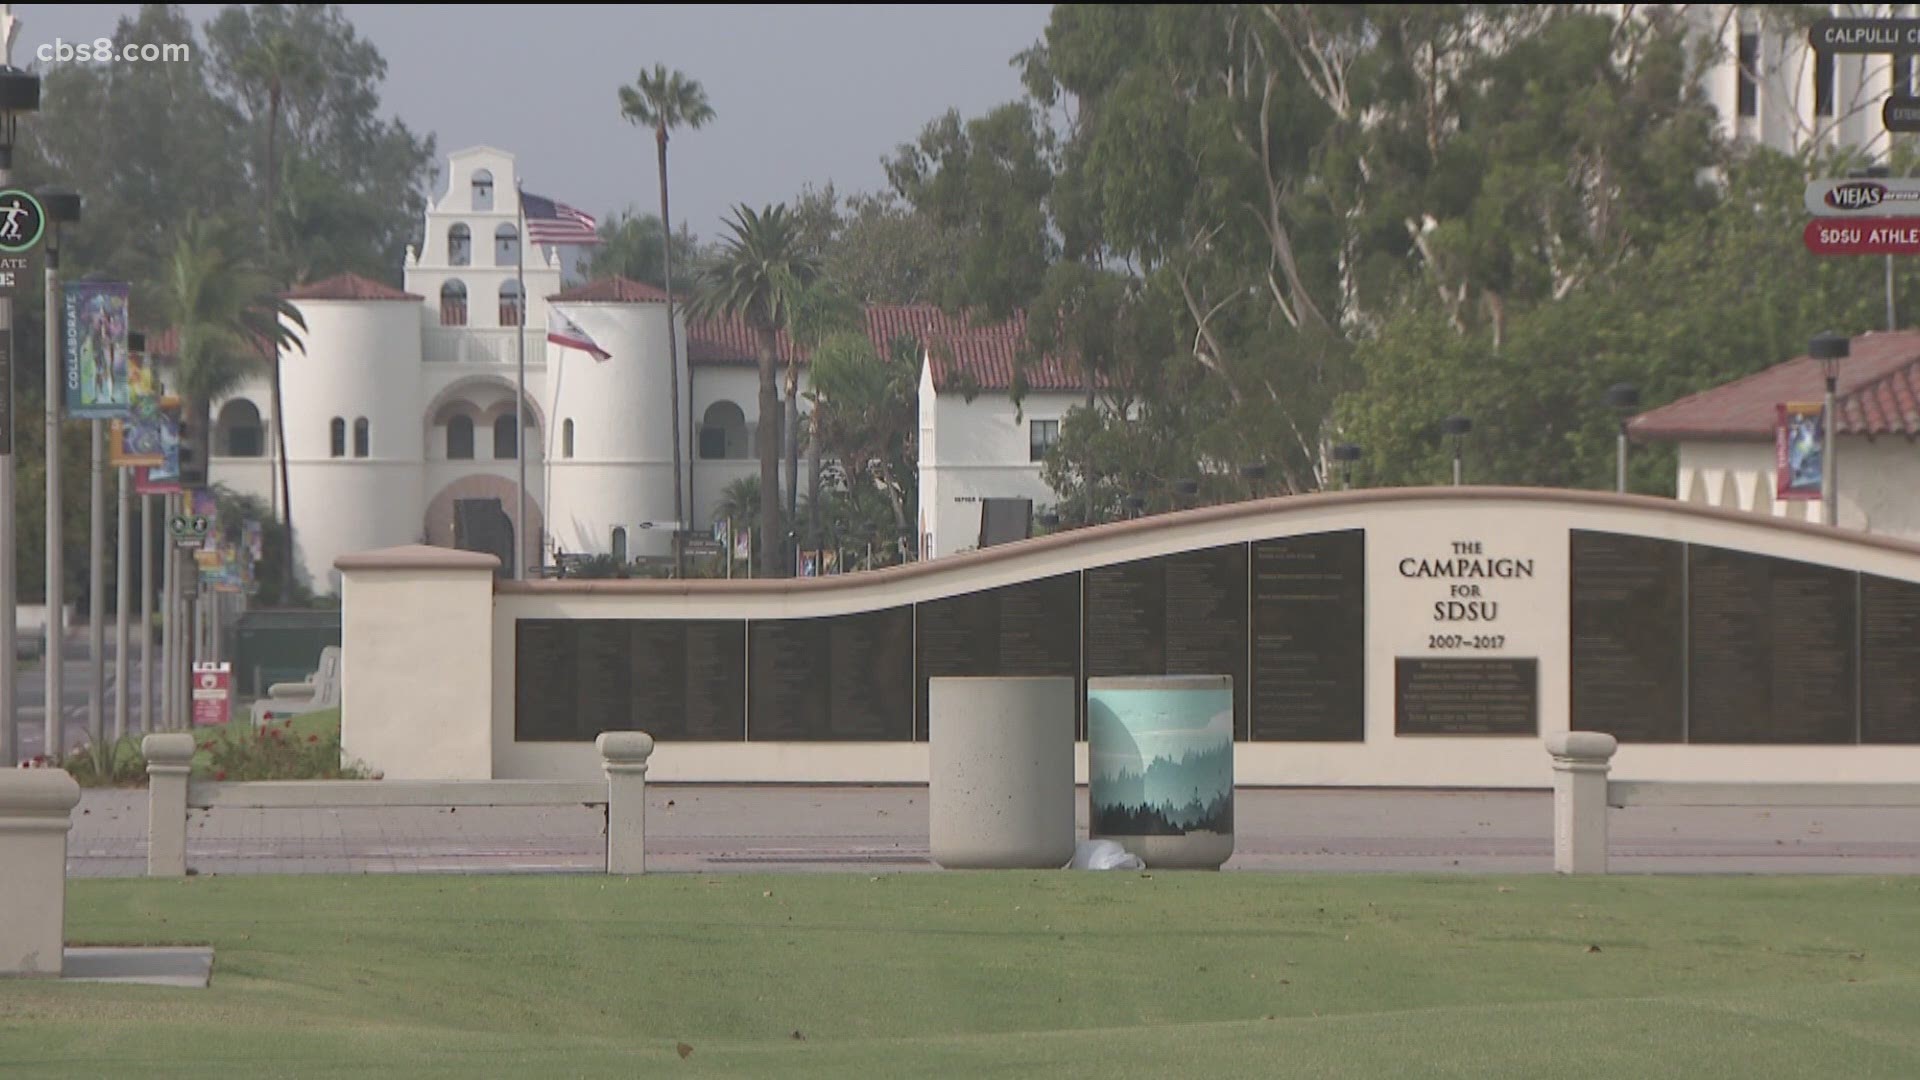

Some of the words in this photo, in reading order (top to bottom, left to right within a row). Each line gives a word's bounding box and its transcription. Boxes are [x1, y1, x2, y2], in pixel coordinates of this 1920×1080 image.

[1825, 28, 1899, 43] CALPULLI
[1833, 186, 1880, 208] VIEJAS
[1820, 229, 1861, 243] SDSU
[1869, 229, 1920, 243] ATHLE
[66, 294, 78, 390] COLLABORATE
[1451, 541, 1483, 555] THE
[1399, 558, 1534, 578] CAMPAIGN
[1450, 584, 1480, 597] FOR
[1433, 601, 1497, 621] SDSU
